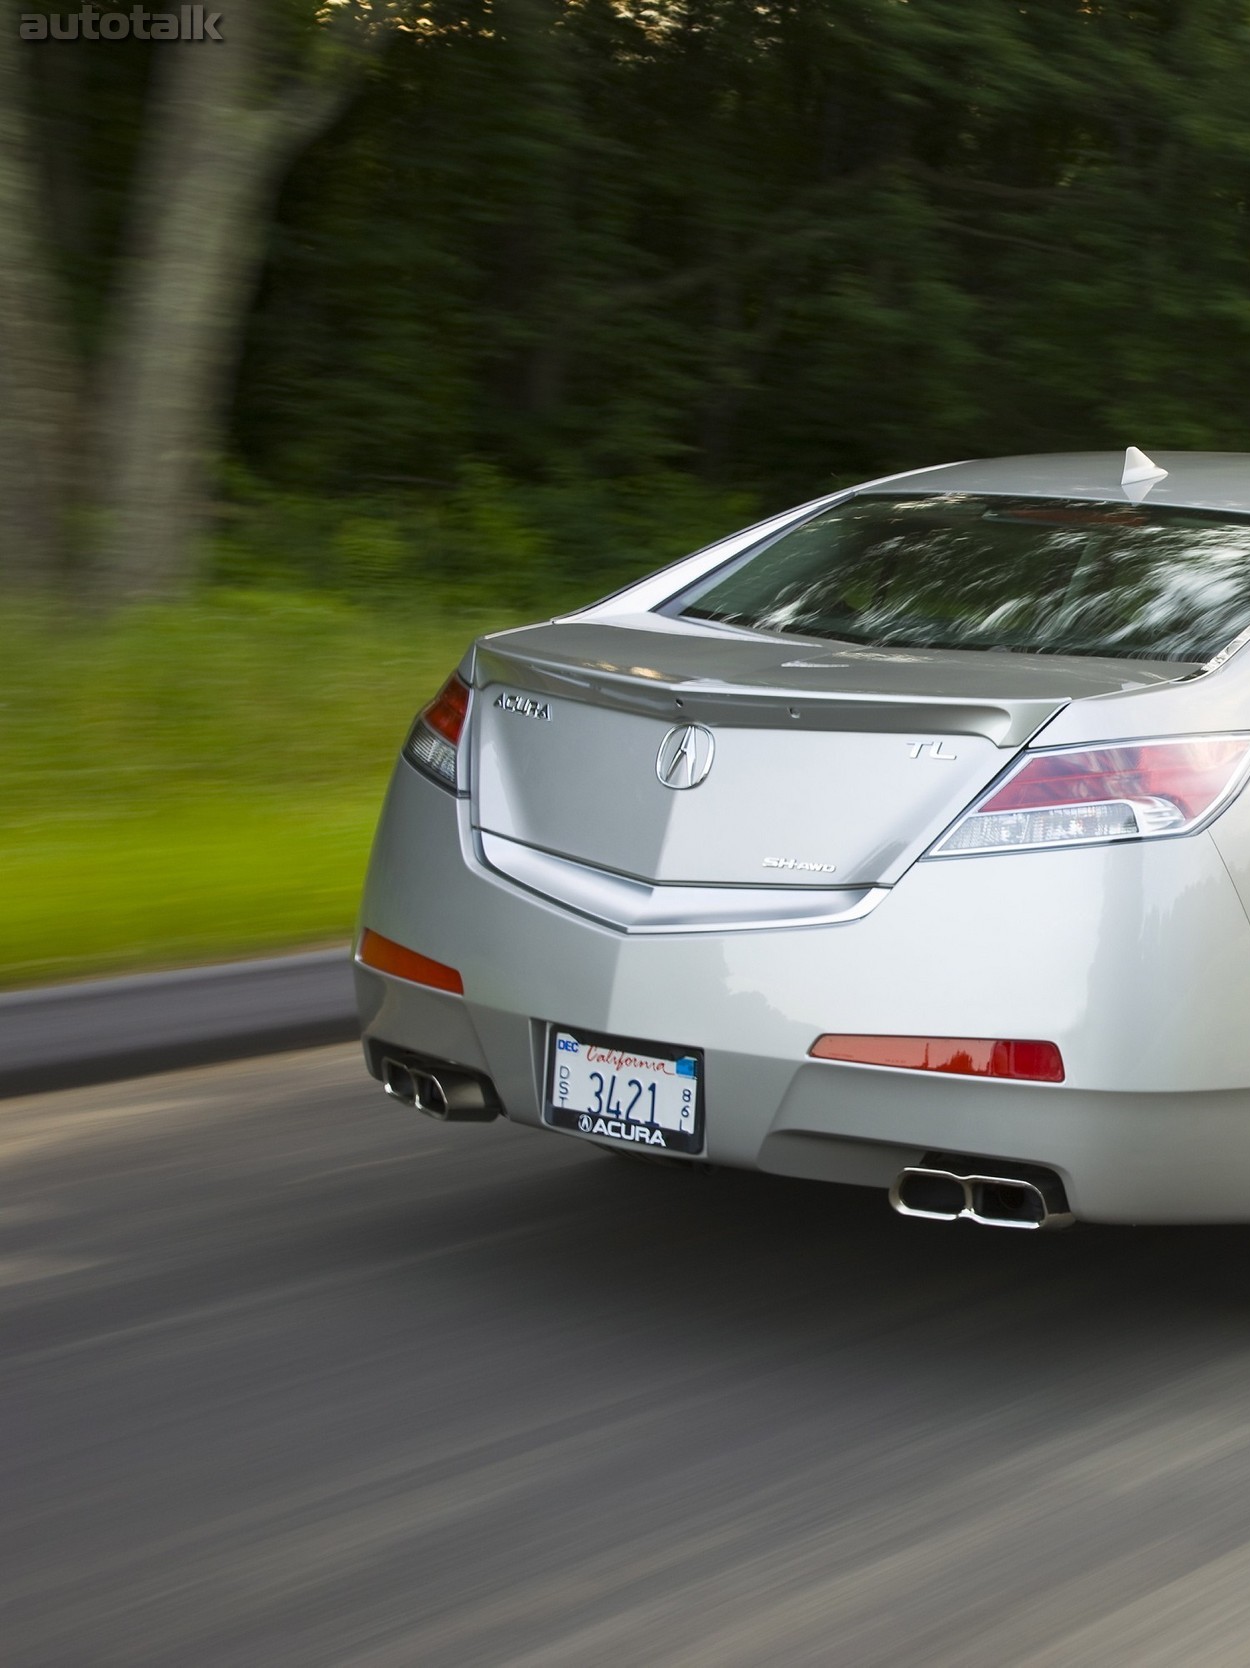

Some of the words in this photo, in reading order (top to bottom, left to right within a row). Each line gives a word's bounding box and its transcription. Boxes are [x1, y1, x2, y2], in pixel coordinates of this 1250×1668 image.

[493, 692, 551, 721] ACURA
[906, 741, 957, 760] TL
[558, 1039, 579, 1053] DEC
[586, 1045, 675, 1075] California
[587, 1071, 661, 1128] 3421
[593, 1119, 667, 1147] ACURA
